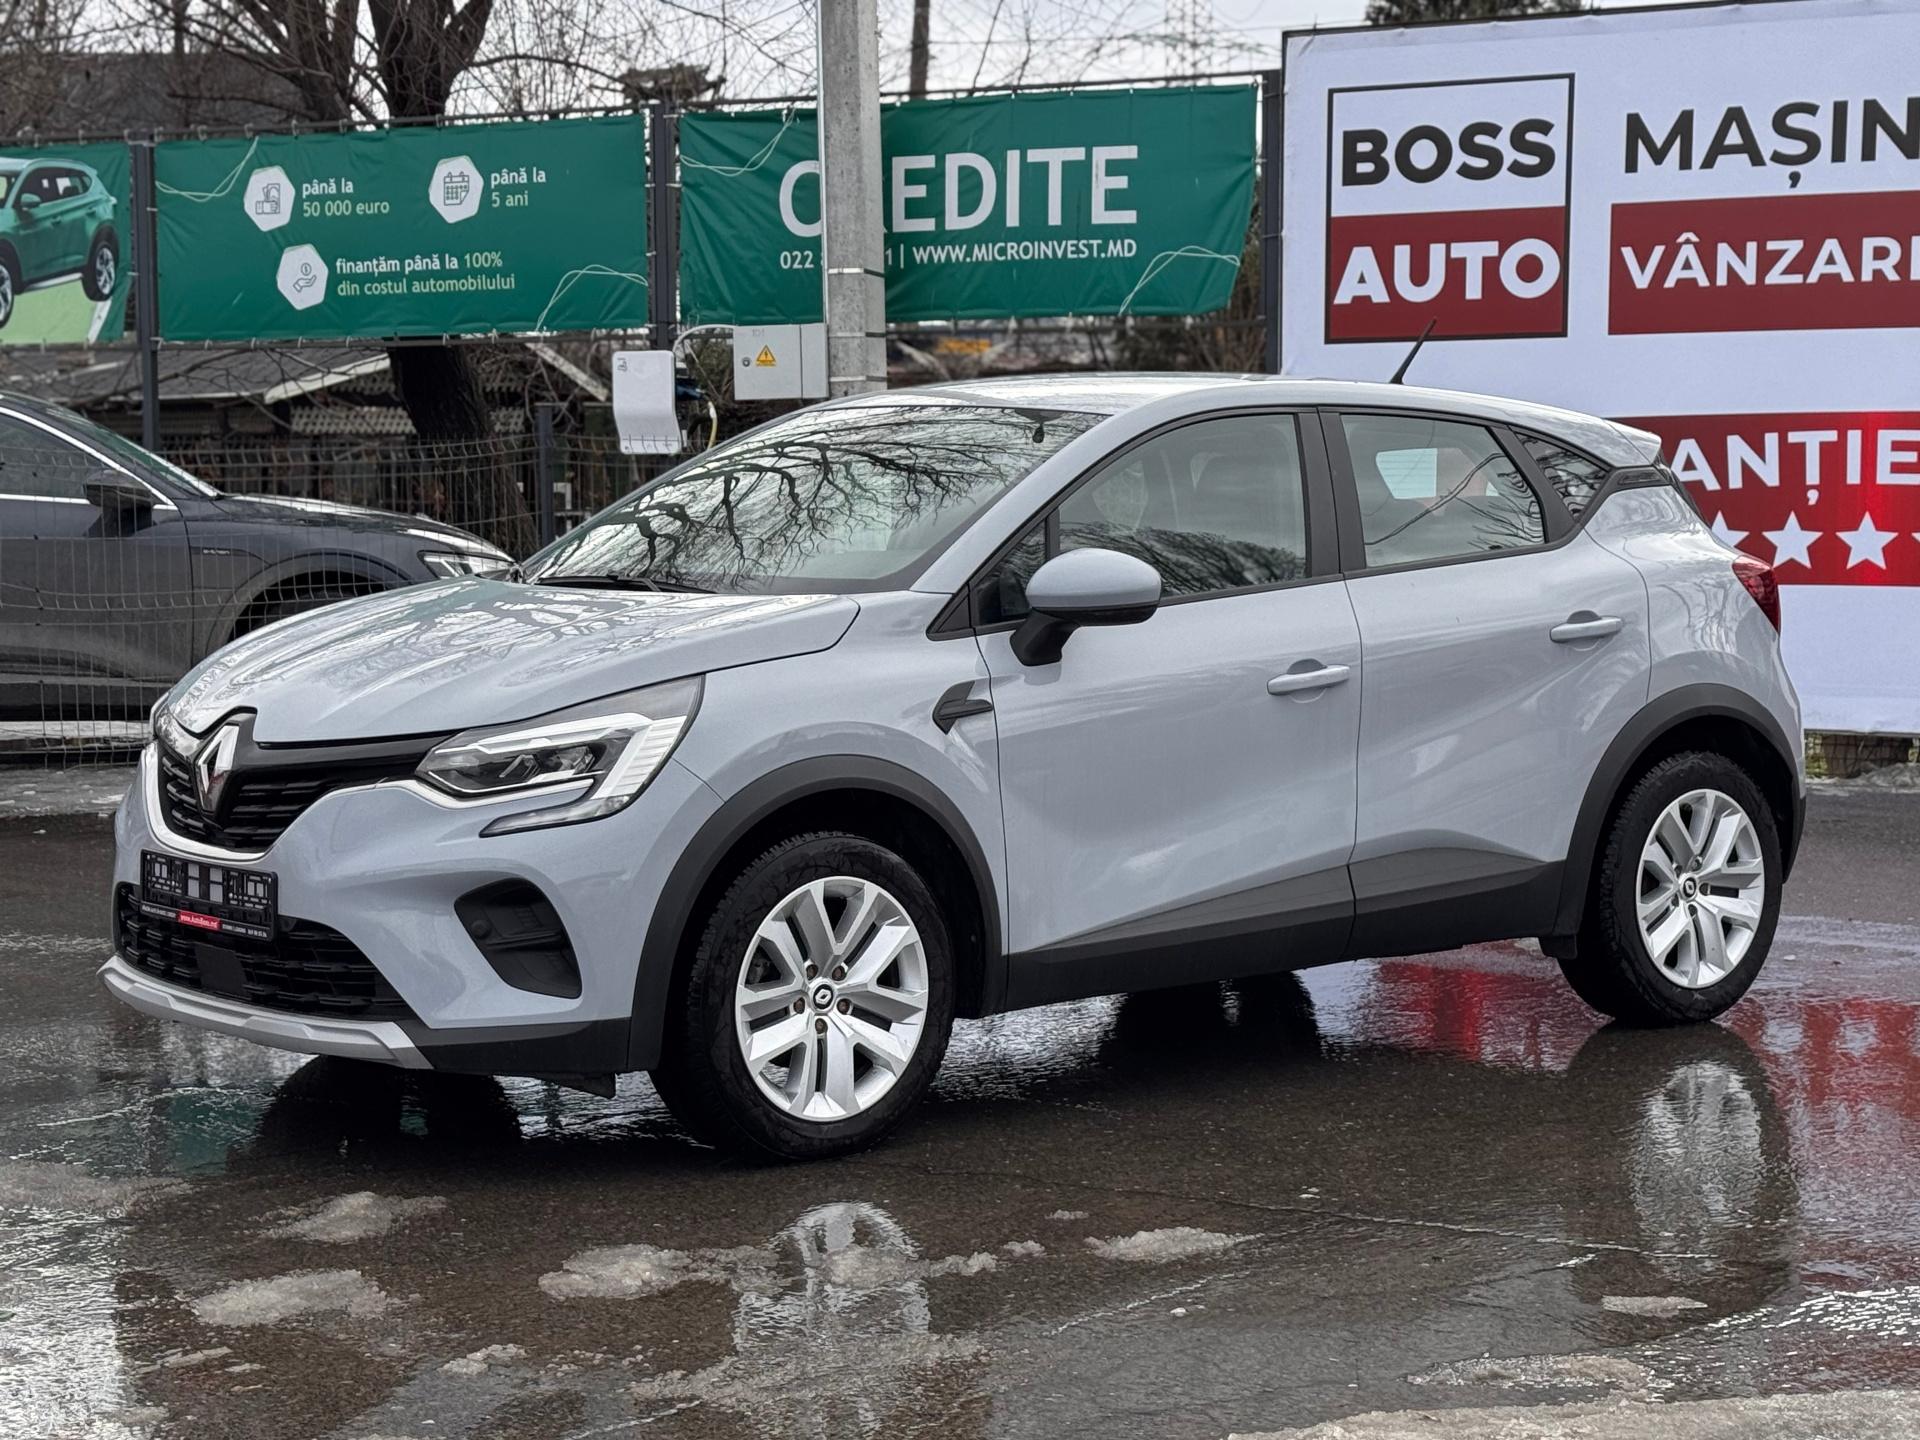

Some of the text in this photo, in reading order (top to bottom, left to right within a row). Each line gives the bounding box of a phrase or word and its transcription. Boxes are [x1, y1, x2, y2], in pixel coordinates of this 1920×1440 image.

[1341, 118, 1556, 187] BOSS
[1625, 96, 1920, 188] MAȘIN
[302, 177, 354, 199] până la
[490, 166, 547, 189] până la
[779, 144, 1139, 238] CEDITE
[303, 200, 390, 218] 50 000 euro
[491, 190, 529, 208] 5 ani
[335, 250, 503, 278] finanțăm până la 100%
[779, 250, 815, 270] 022
[912, 237, 1138, 264] WWW.MICROINVEST.MD
[337, 273, 516, 297] din costul automobilului
[1333, 237, 1562, 306] AUTO
